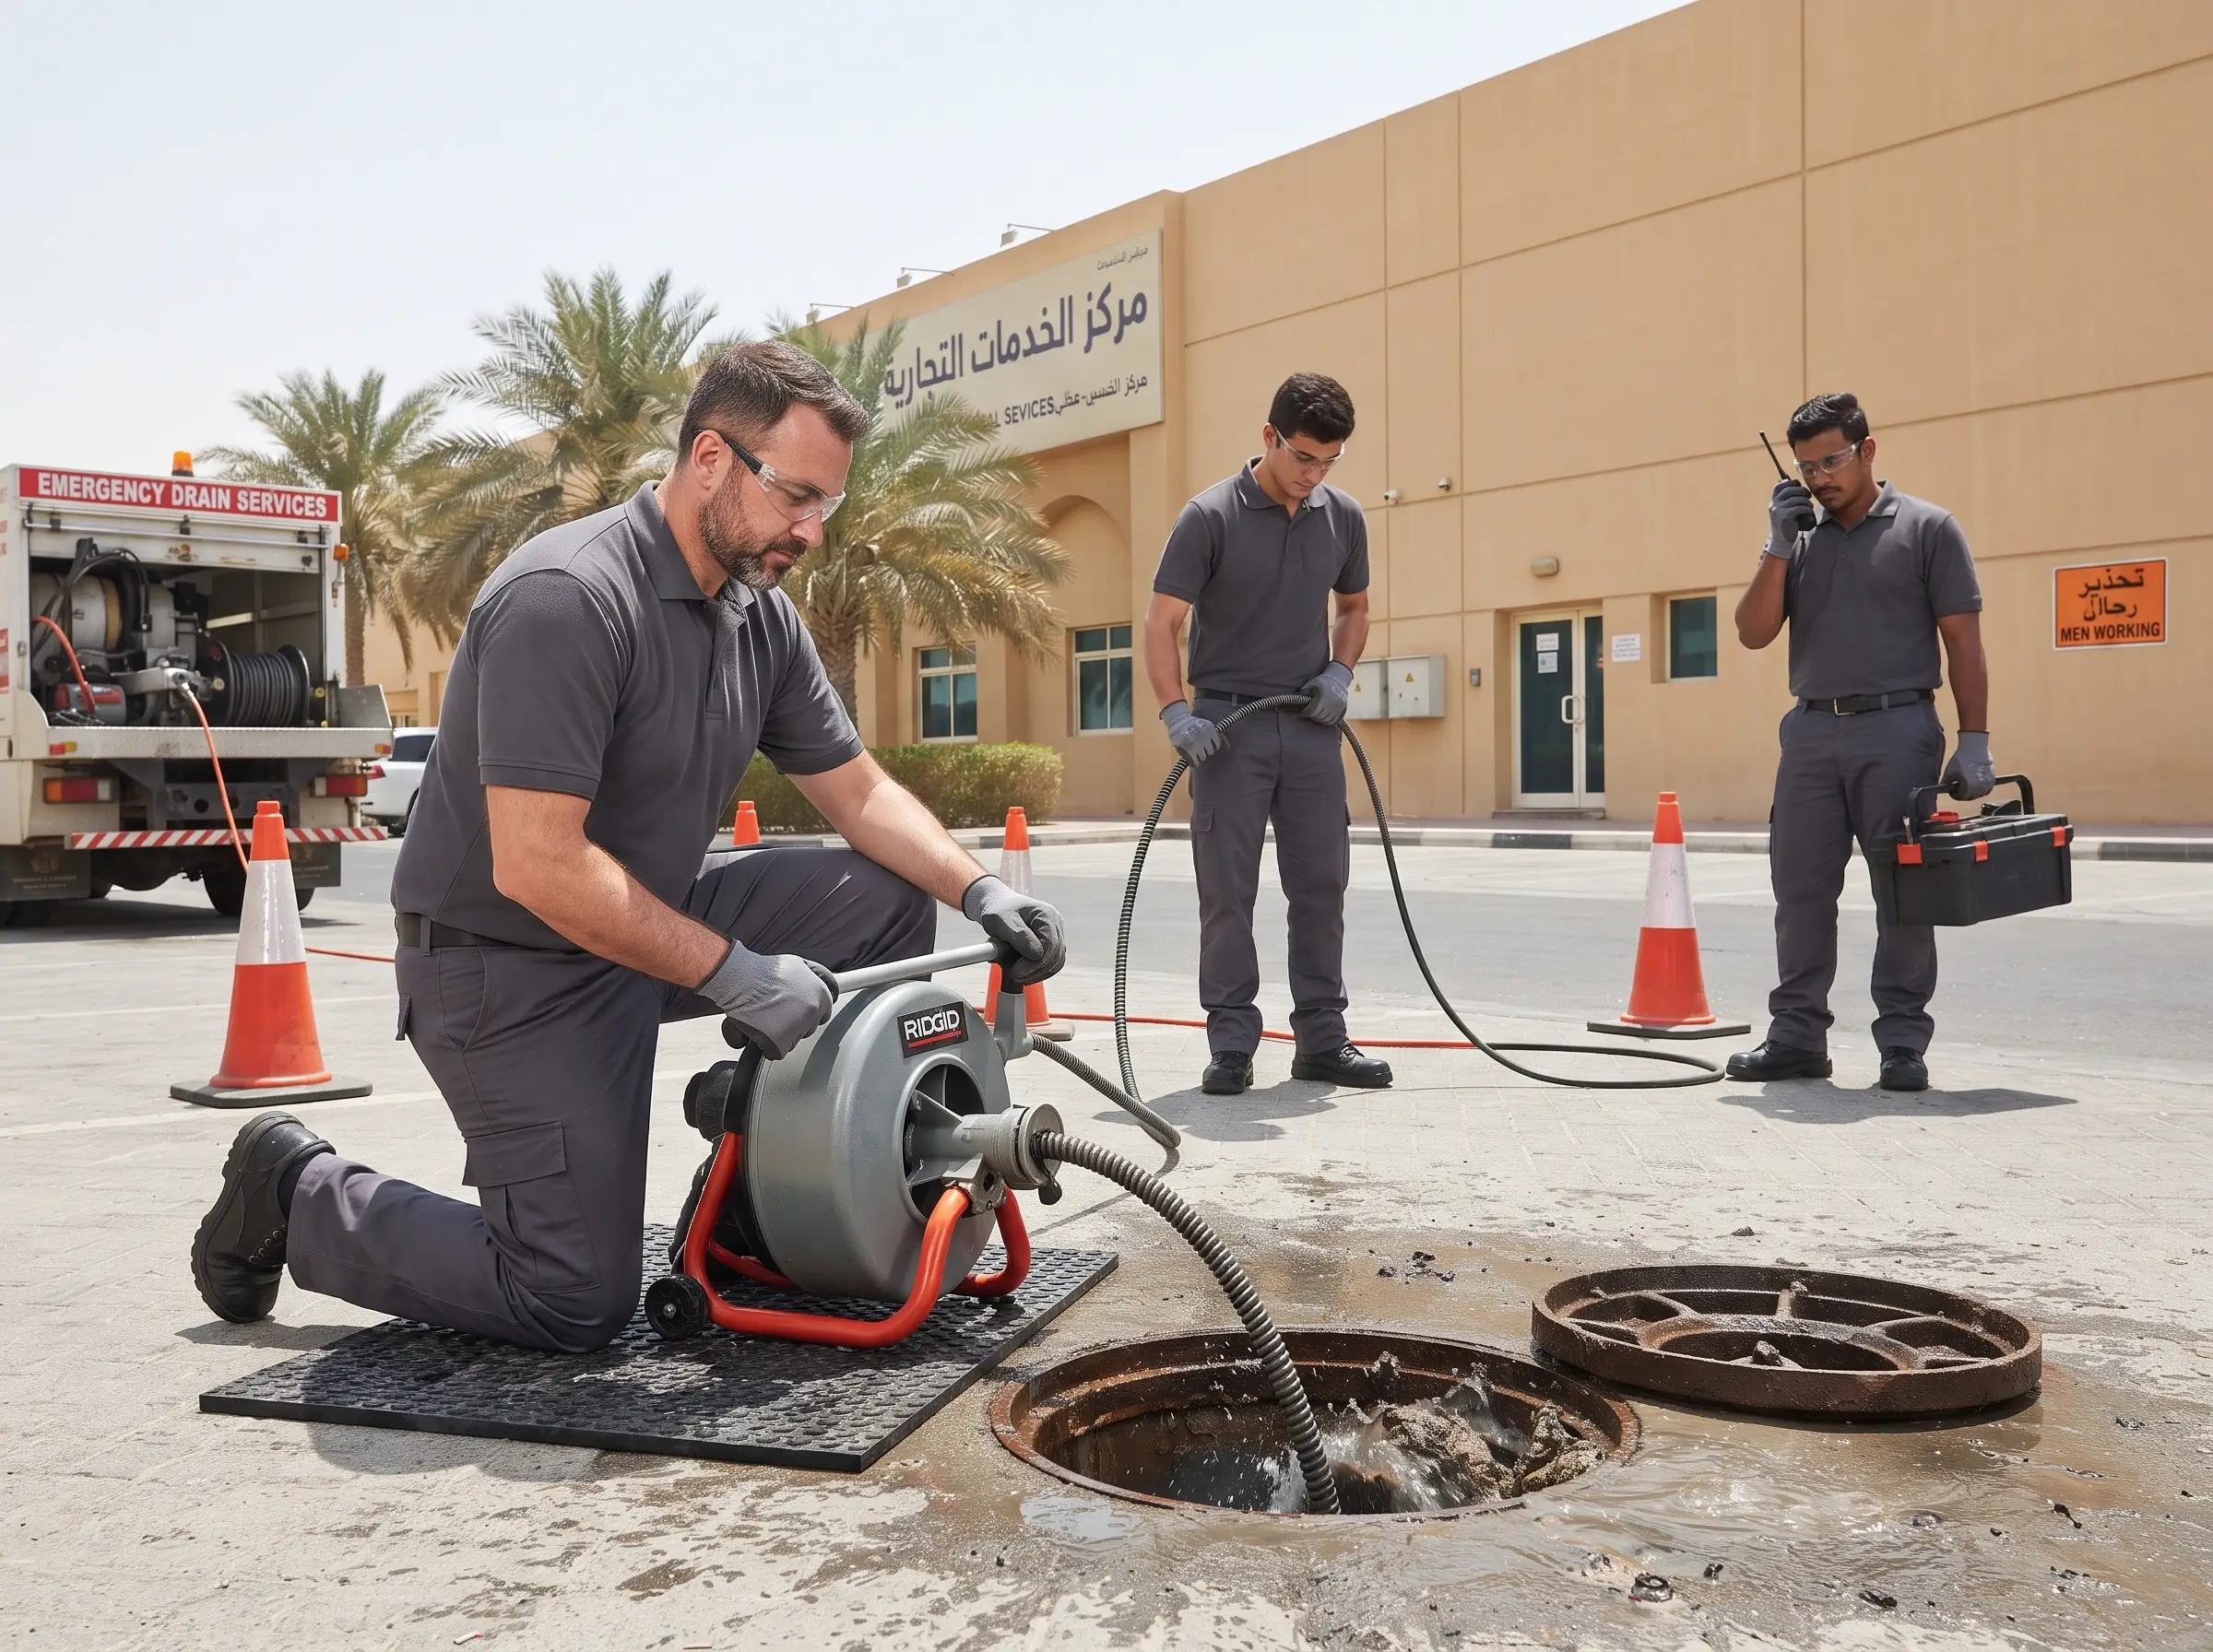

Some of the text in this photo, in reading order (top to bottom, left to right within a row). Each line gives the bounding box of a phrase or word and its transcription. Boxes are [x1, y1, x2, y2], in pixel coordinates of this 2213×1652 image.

[884, 281, 1148, 409] مركز الخدمات التجارية
[1124, 373, 1148, 397] مركز
[1004, 395, 1055, 425] SEVICES
[38, 471, 165, 505] EMERGENCY
[172, 484, 231, 511] DRAIN
[237, 490, 327, 518] SERVICES
[2078, 568, 2145, 598] تحذير
[2060, 621, 2160, 643] MEN WORKING
[903, 1009, 960, 1041] RIDGID
